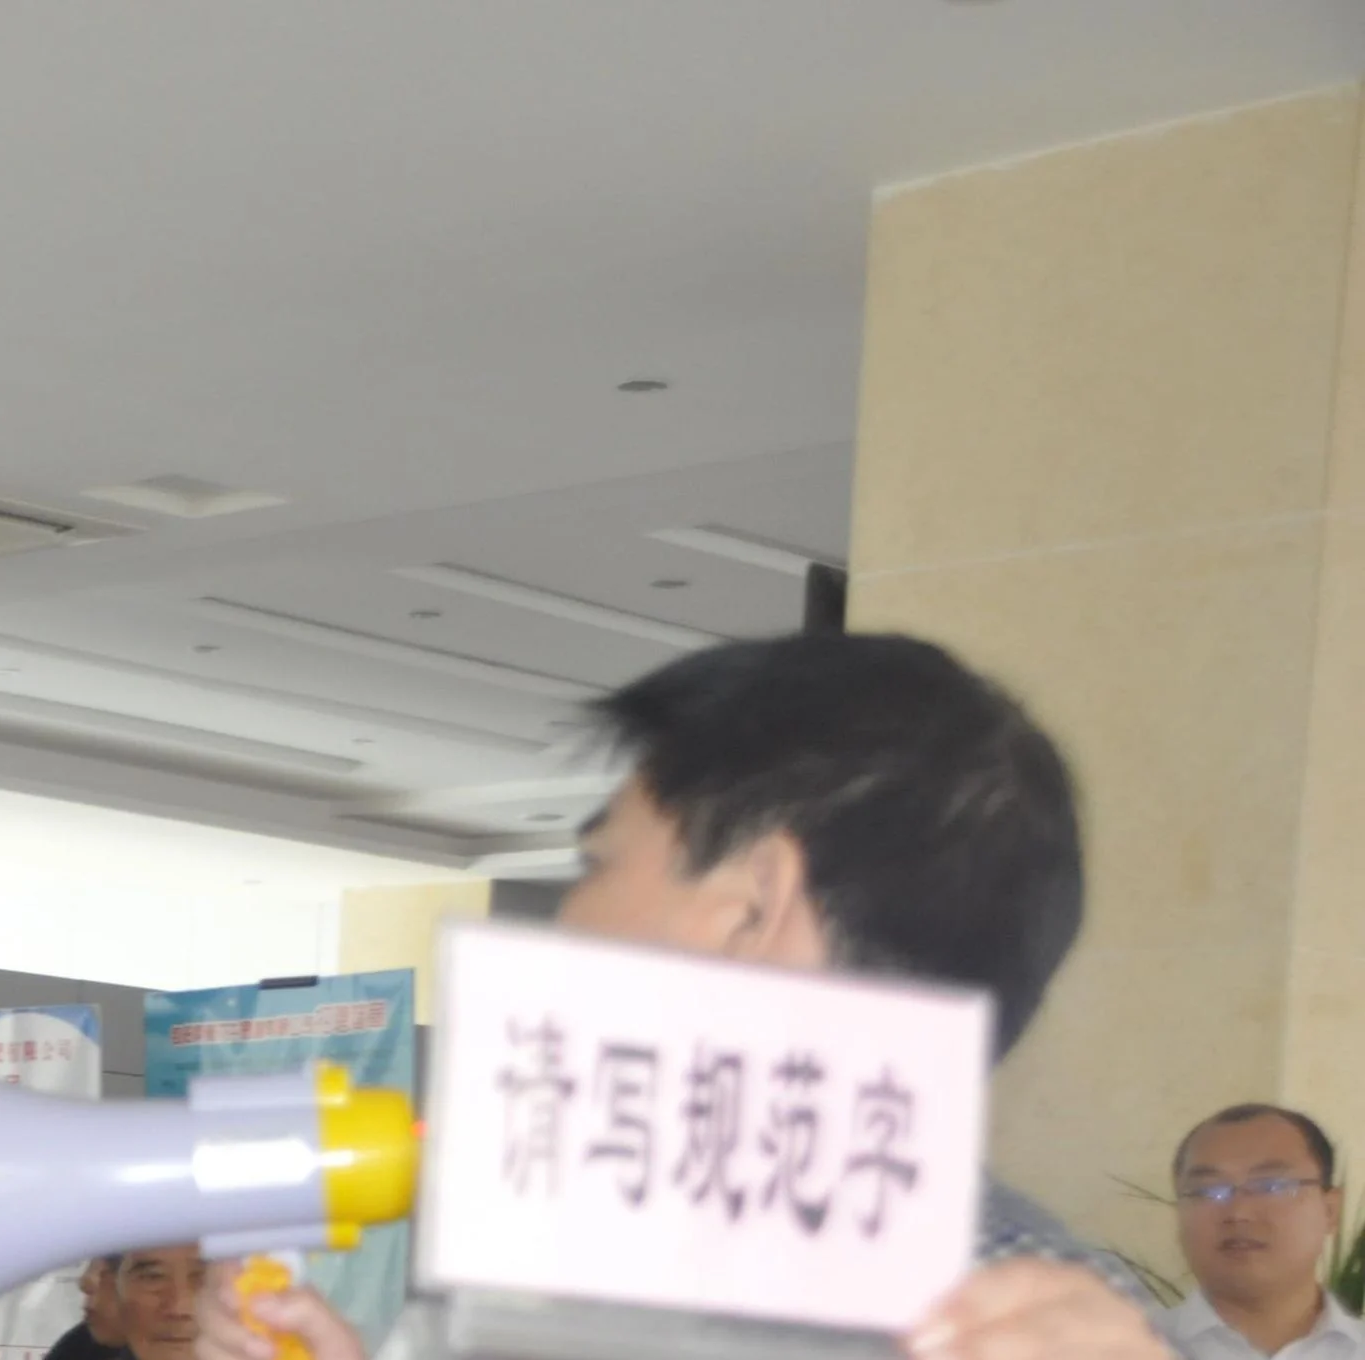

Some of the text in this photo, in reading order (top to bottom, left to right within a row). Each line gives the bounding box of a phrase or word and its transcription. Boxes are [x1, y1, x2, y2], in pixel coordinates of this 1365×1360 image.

[497, 1012, 920, 1238] 请写规范字
